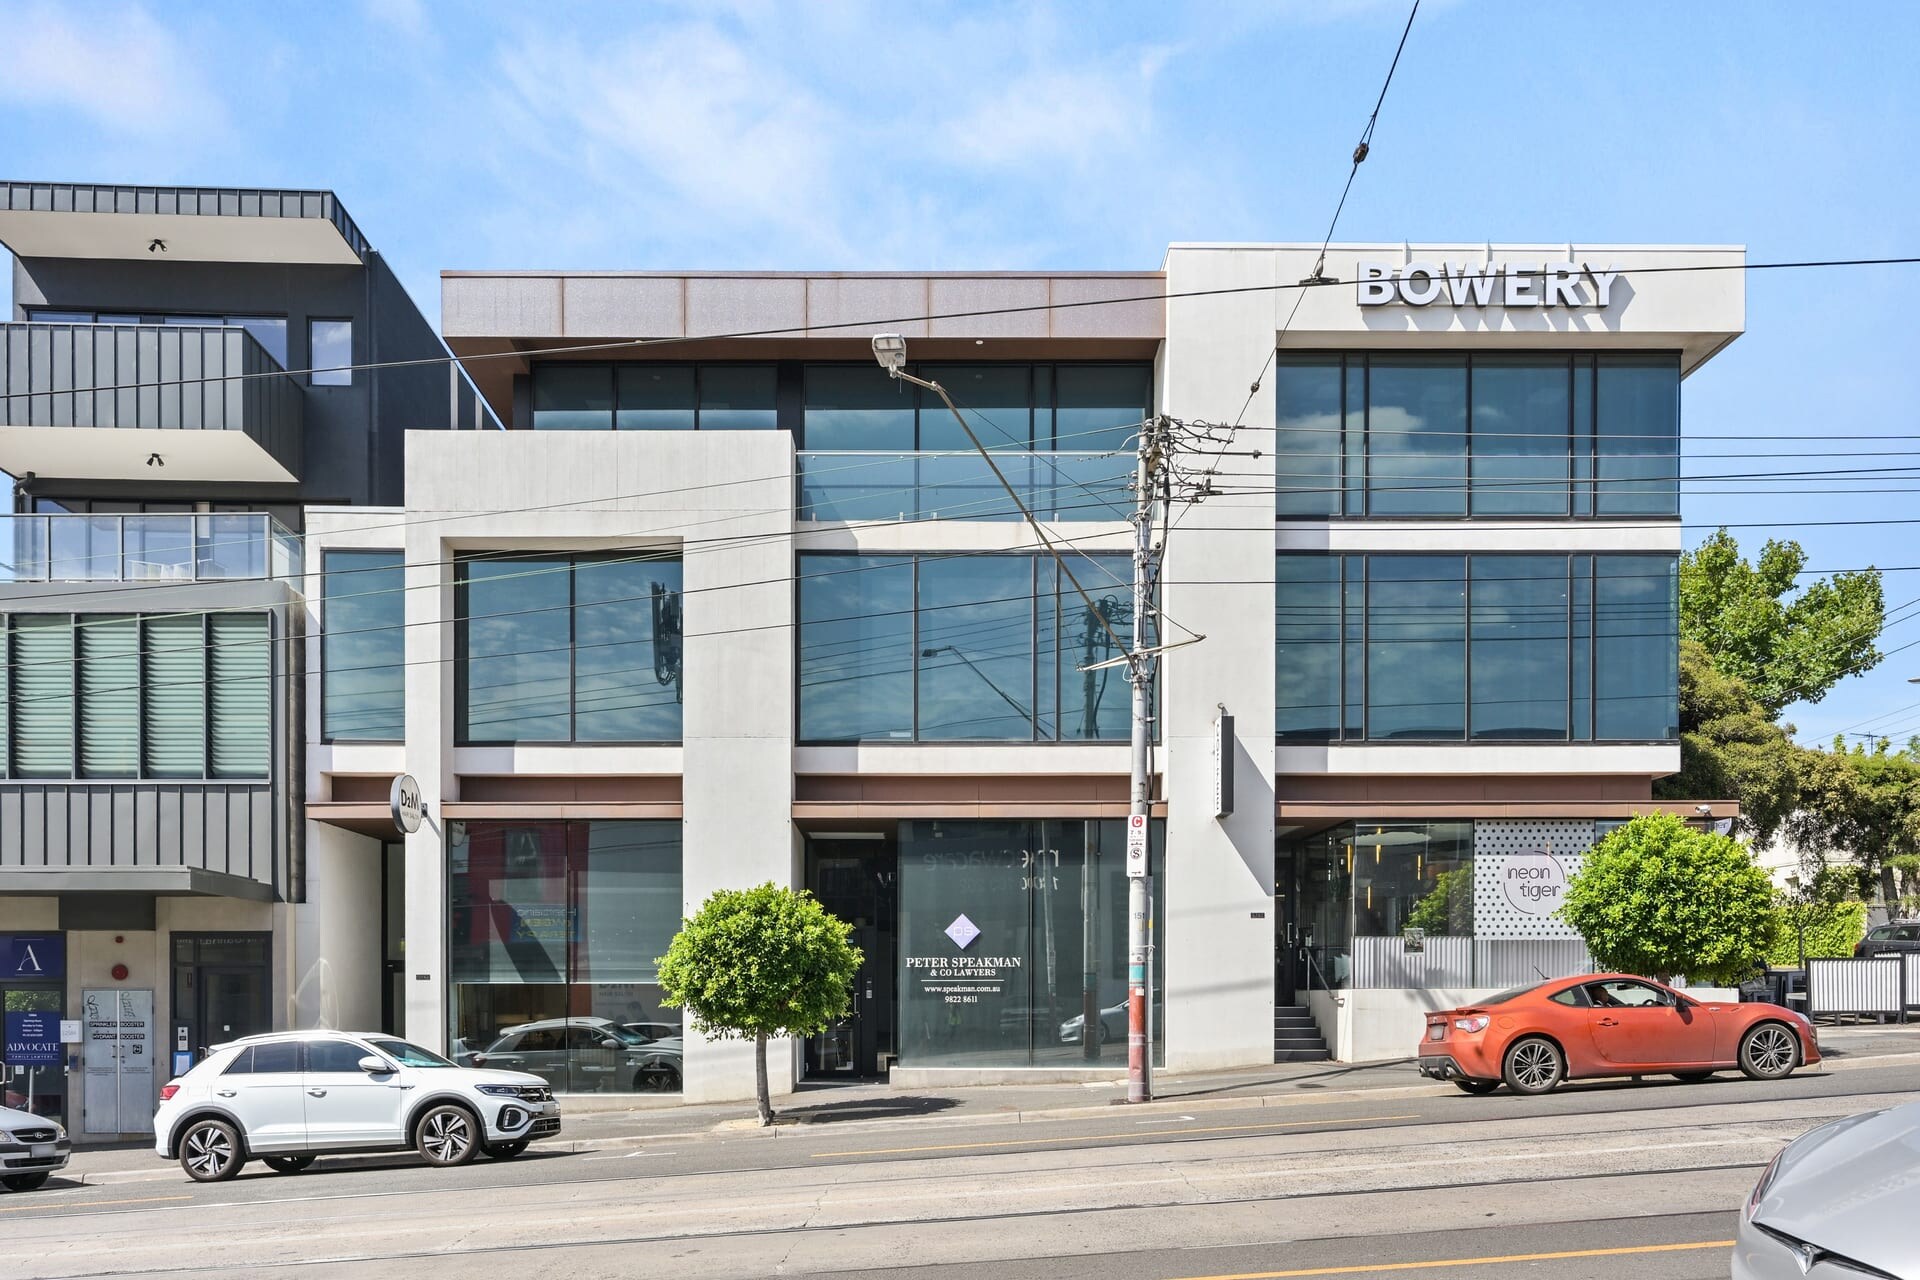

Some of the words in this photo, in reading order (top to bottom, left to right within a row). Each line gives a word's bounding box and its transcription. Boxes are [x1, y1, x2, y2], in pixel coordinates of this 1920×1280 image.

[1357, 260, 1620, 307] BOWERY
[1507, 867, 1550, 879] neon
[1520, 880, 1560, 901] tiger
[16, 944, 42, 971] A
[905, 957, 948, 968] PETER
[951, 957, 1021, 968] SPEAKMAN
[924, 985, 1001, 994] www.speakman.com.au
[6, 1042, 59, 1051] ADVOCATE
